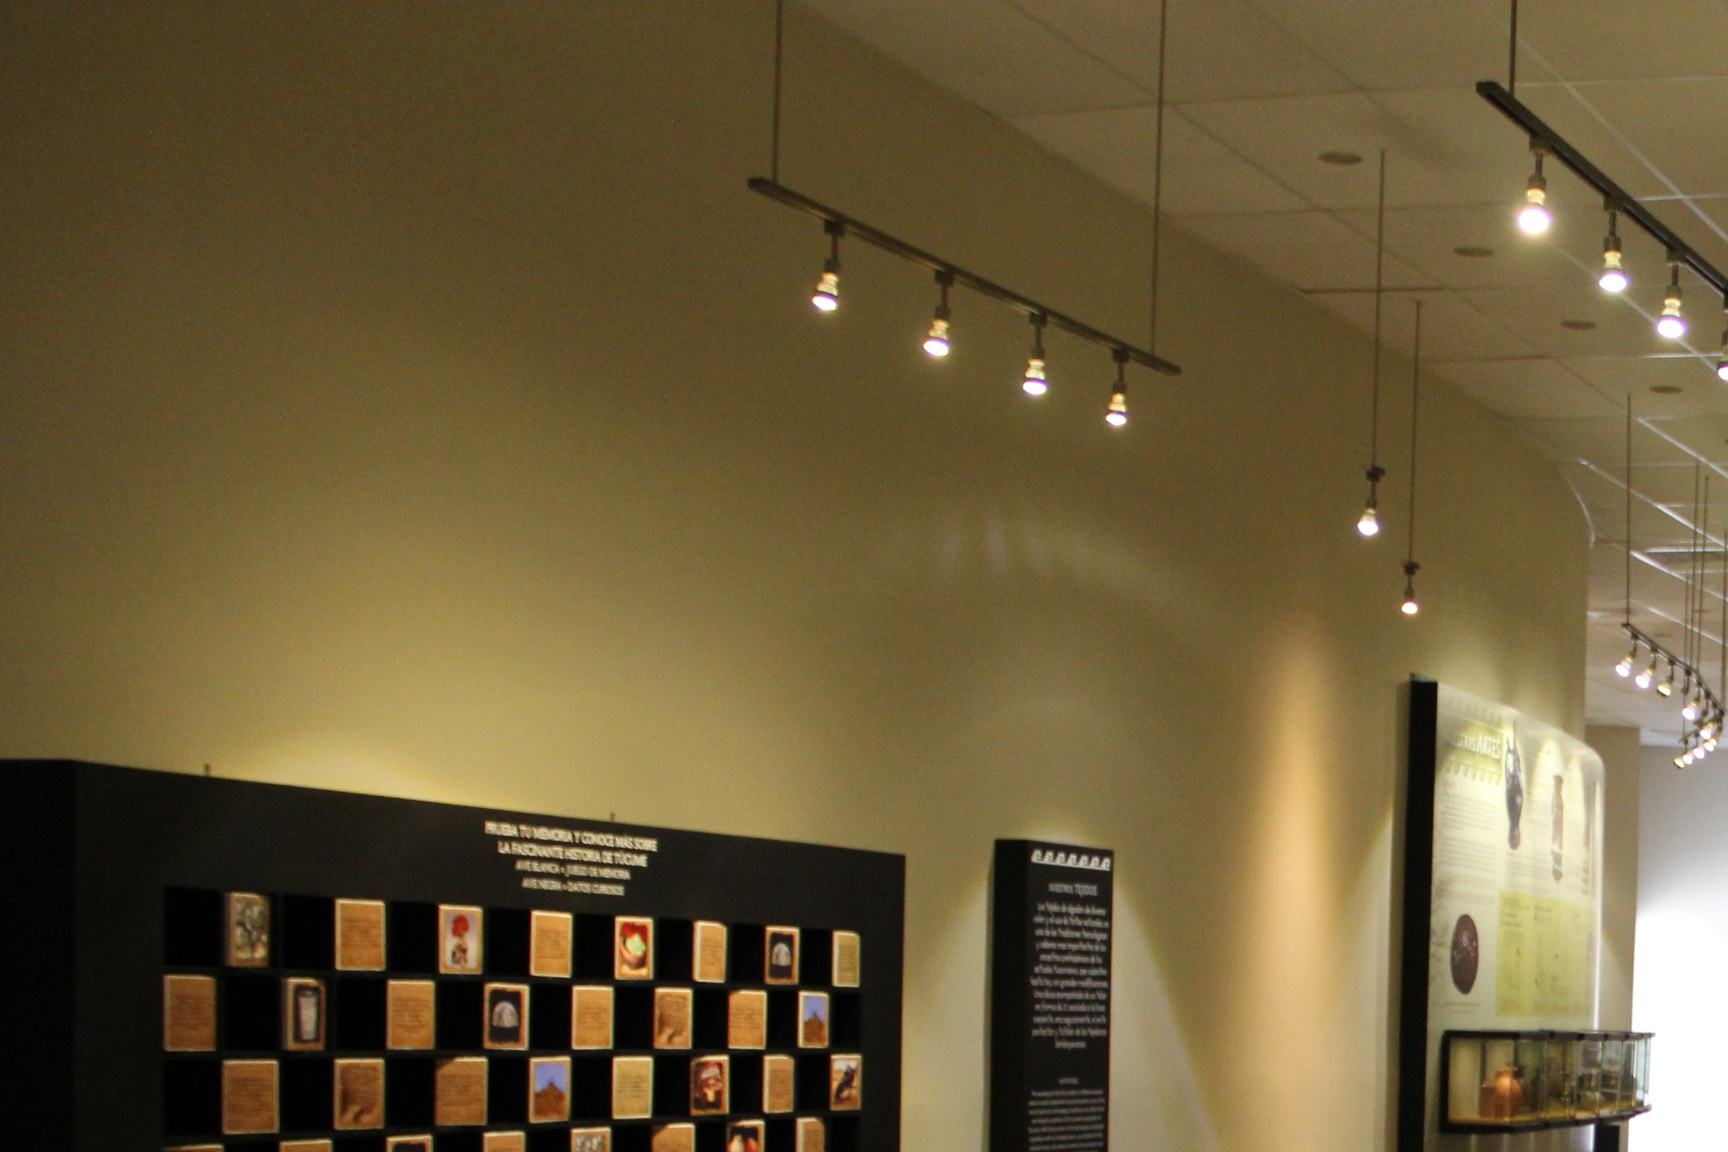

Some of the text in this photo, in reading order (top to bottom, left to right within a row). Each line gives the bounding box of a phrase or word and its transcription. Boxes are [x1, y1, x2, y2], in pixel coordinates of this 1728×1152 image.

[1475, 732, 1501, 760] ARTES
[484, 821, 518, 837] PRUEBA
[519, 824, 533, 839] TU
[532, 826, 573, 843] MEMORIA
[572, 830, 580, 843] Y
[580, 831, 614, 848] CONOCE
[632, 837, 657, 852] SOBRE
[498, 841, 511, 854] LA
[510, 842, 563, 859] FASCINANTE
[563, 847, 601, 863] HISTORIA
[601, 850, 613, 864] DE
[598, 868, 630, 880] MEMORIA
